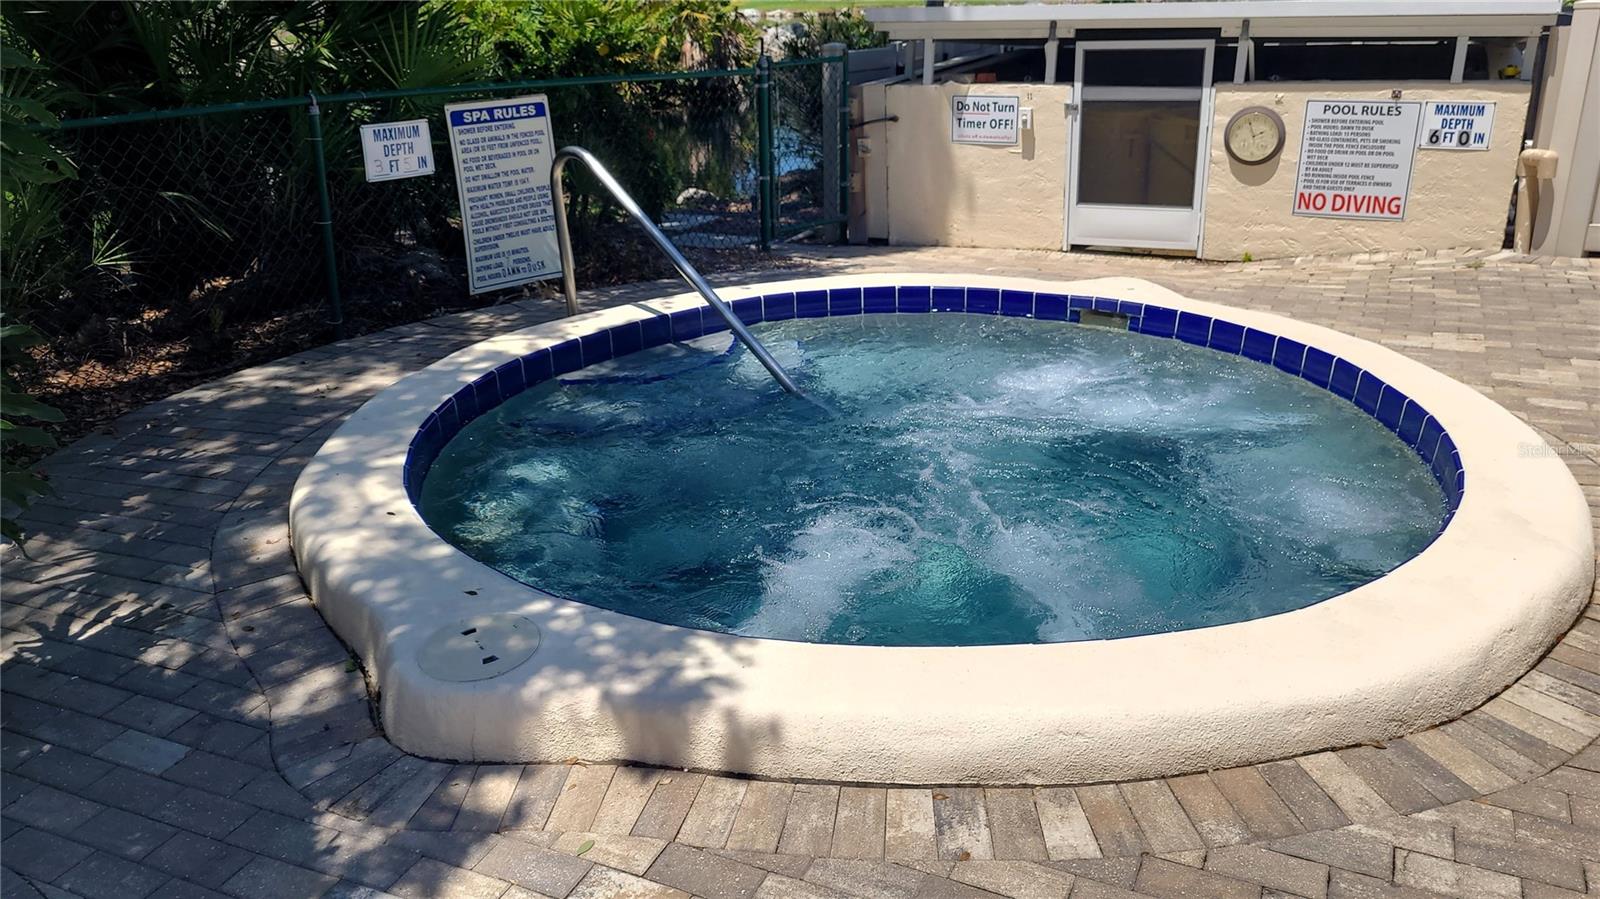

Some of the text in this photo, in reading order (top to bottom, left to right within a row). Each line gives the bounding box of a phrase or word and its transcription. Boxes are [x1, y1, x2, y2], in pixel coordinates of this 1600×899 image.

[463, 105, 536, 123] SPA RULES
[956, 101, 1014, 112] Do Not Turn
[1323, 105, 1402, 116] POOL RULES
[1435, 104, 1485, 116] MAXIMUM
[957, 118, 1013, 130] Timer OFF!
[1441, 118, 1474, 130] DEPTH
[373, 125, 420, 142] MAXIMUM
[1430, 130, 1485, 145] 6 FT 0 IN
[384, 142, 414, 157] DEPTH
[374, 159, 383, 173] 3
[389, 159, 400, 172] FT
[418, 156, 427, 168] IN
[1298, 192, 1401, 214] NO DIVING
